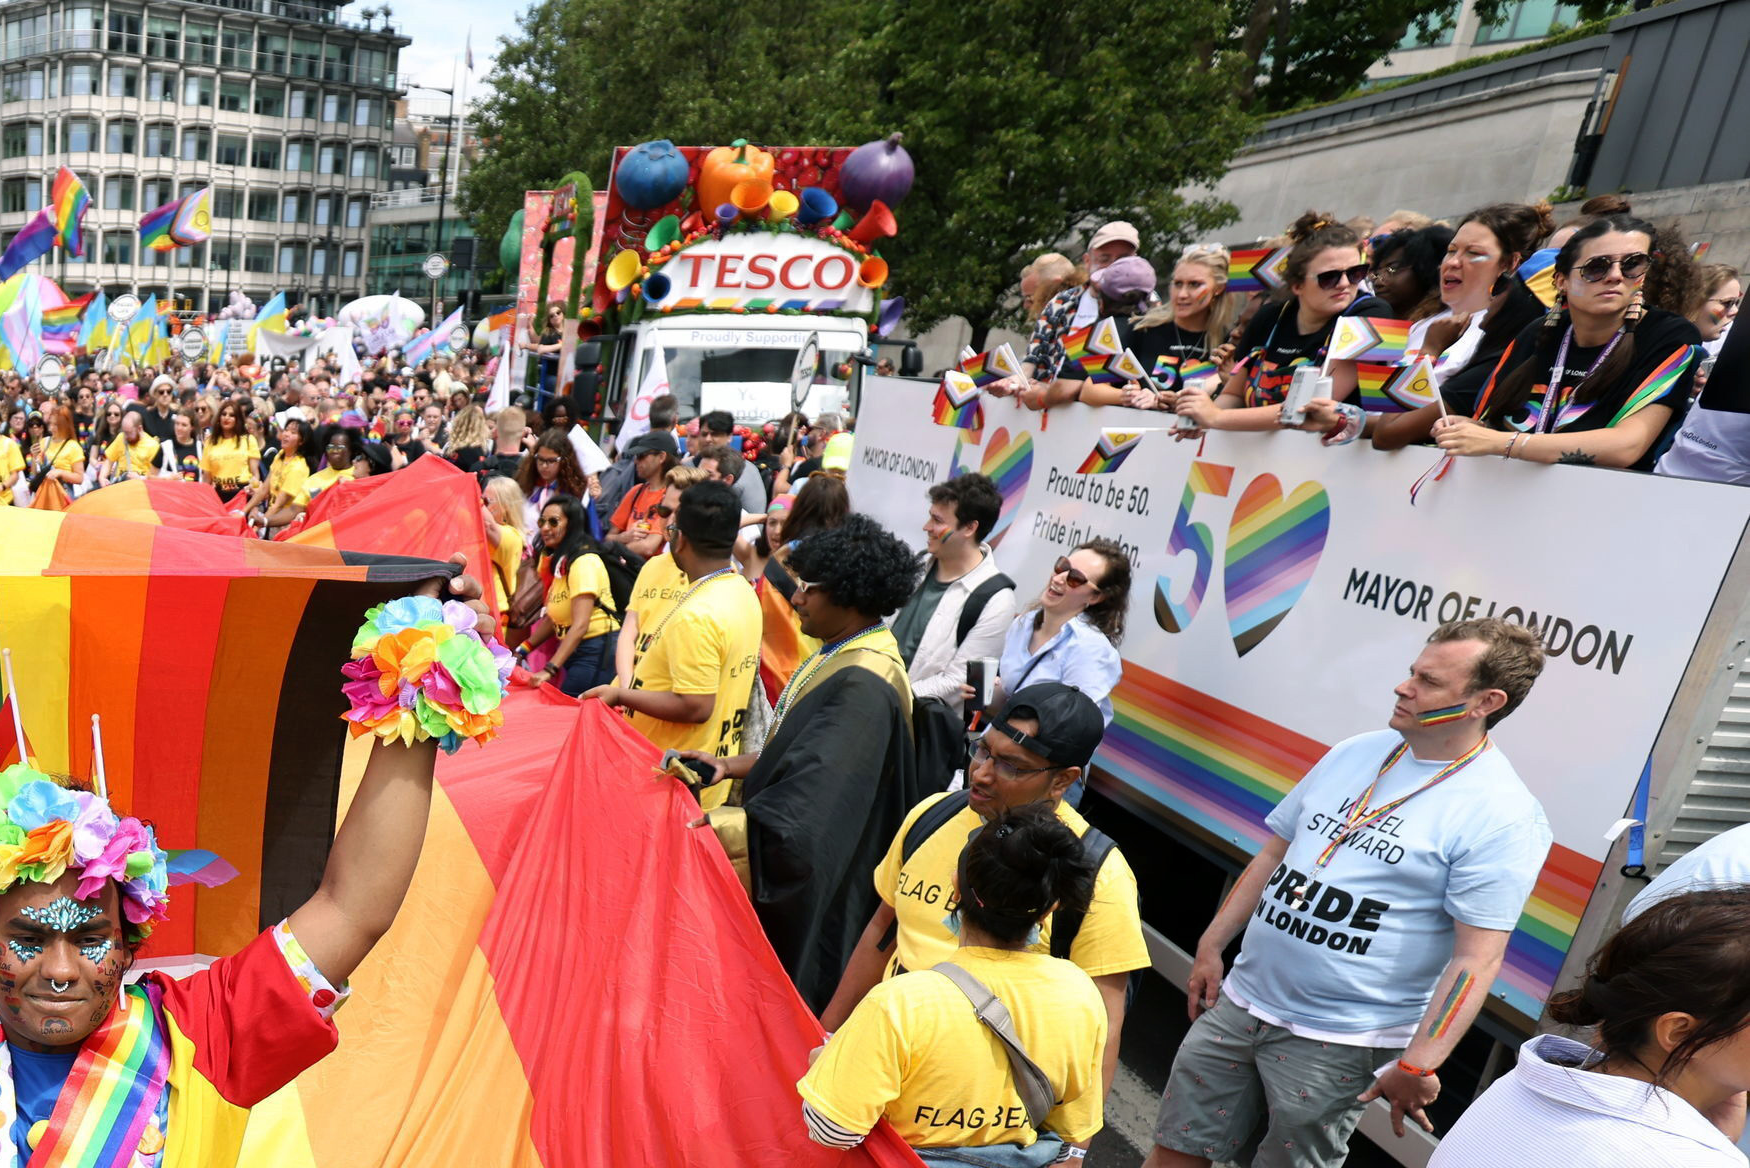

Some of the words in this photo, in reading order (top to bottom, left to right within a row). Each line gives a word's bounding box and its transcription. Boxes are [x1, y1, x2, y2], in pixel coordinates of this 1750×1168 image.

[679, 253, 854, 291] TESCO
[691, 331, 742, 345] Proudly
[862, 445, 888, 470] MAYOR
[888, 453, 901, 472] OF
[900, 455, 938, 483] LONDON
[1046, 466, 1086, 496] Proud
[1087, 477, 1103, 501] to
[1106, 480, 1125, 509] be
[1127, 486, 1150, 517] 50.
[1032, 511, 1065, 545] Pride
[1066, 522, 1081, 547] in
[1342, 567, 1434, 623] MAYOR
[898, 871, 942, 905] FLAG
[1265, 904, 1372, 956] LONDON
[914, 1105, 986, 1130] FLAG
